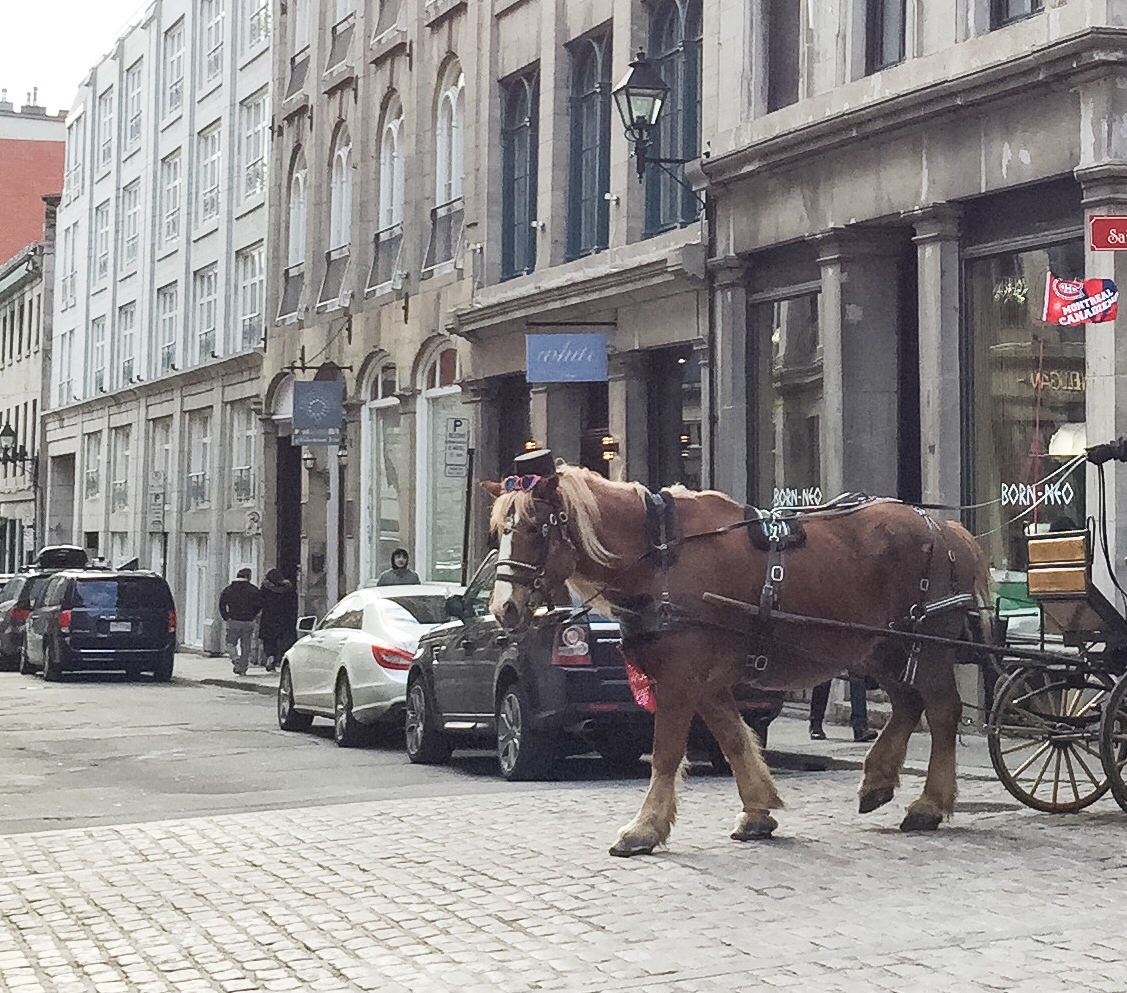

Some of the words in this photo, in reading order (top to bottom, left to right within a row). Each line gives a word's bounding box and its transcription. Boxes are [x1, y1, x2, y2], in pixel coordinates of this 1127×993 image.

[1062, 288, 1114, 316] MONTREAL
[454, 419, 463, 432] P
[773, 487, 822, 507] BORN-NEO
[1001, 482, 1074, 506] BORN-NEO
